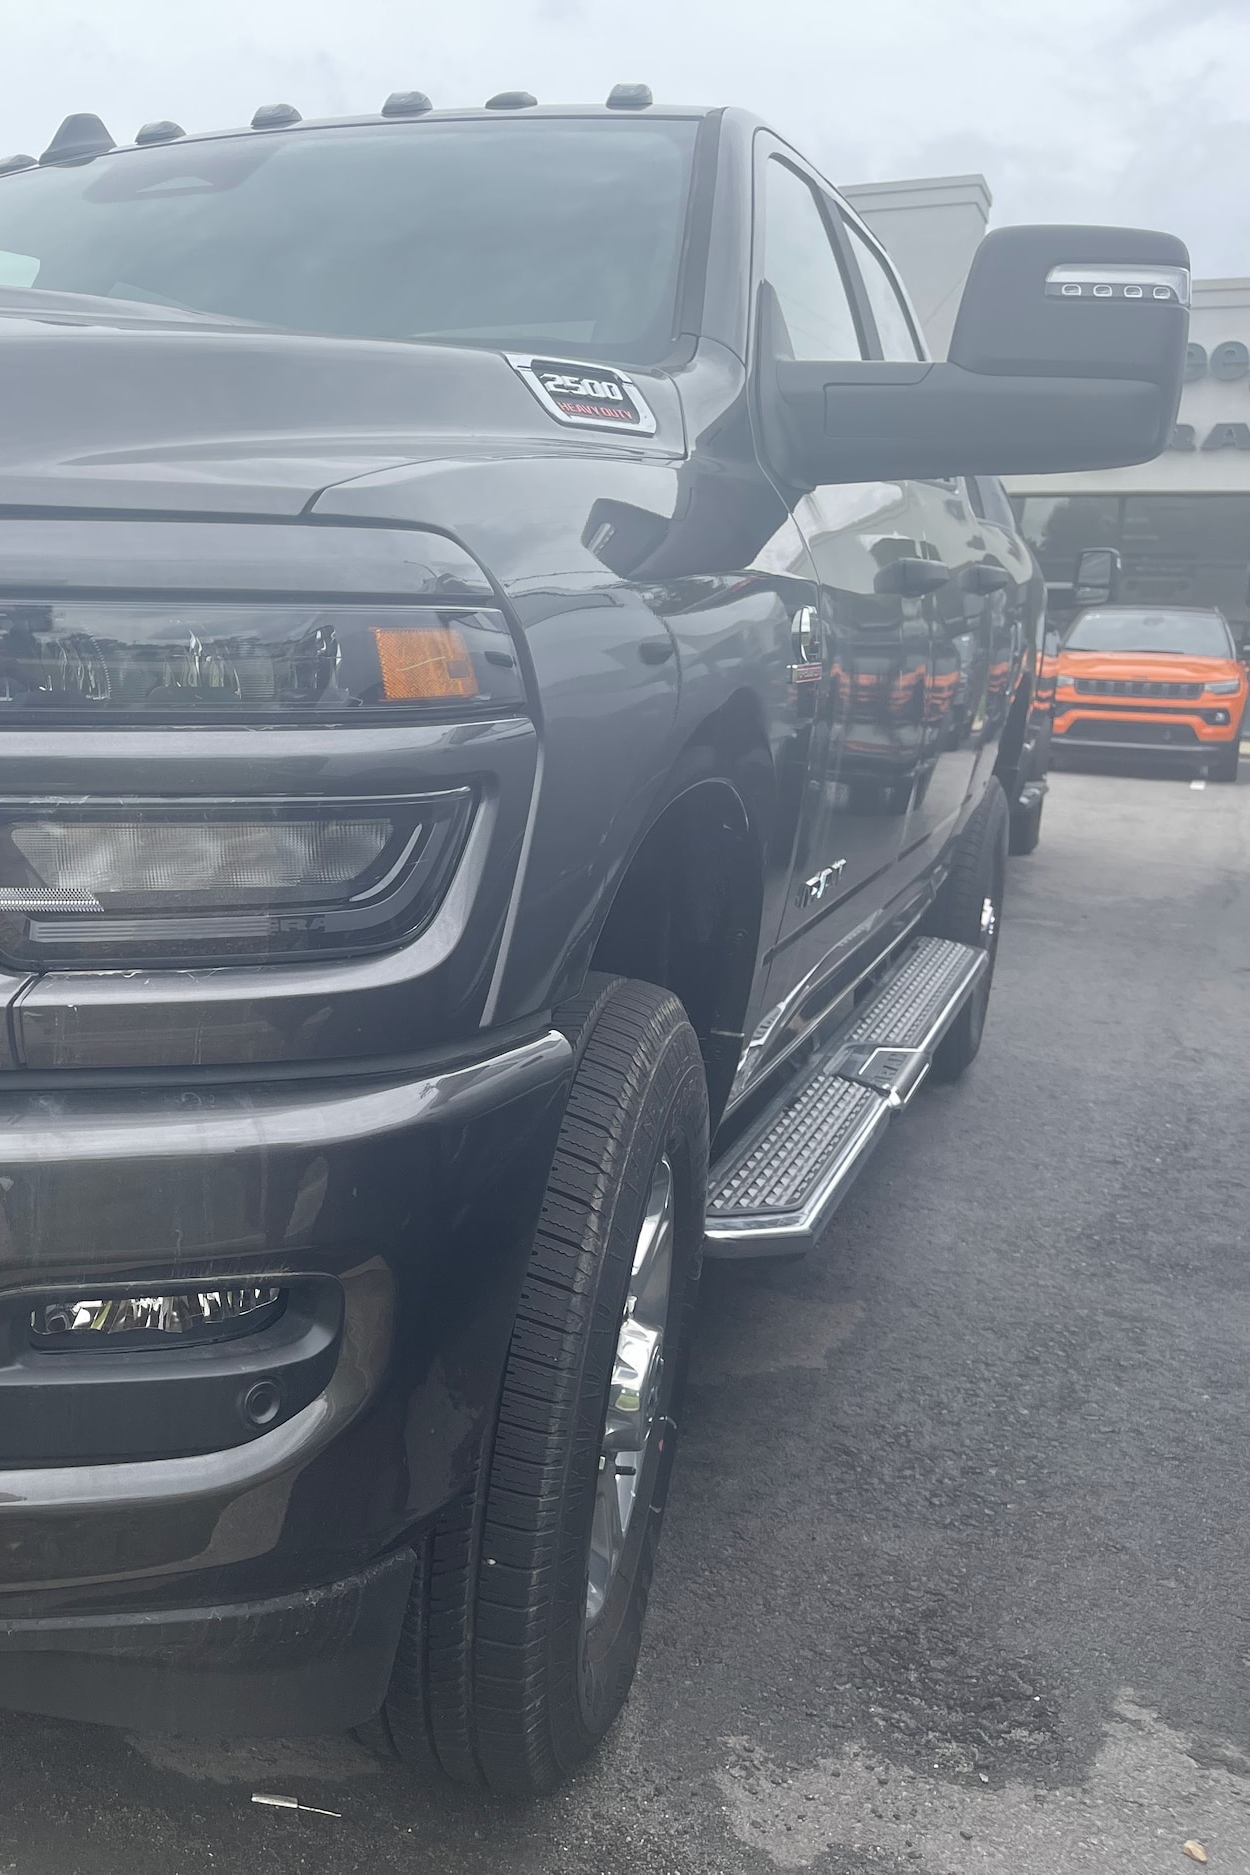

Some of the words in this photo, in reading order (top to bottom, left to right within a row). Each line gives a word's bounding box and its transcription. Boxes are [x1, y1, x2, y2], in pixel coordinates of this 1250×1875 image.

[540, 373, 623, 401] 2500
[557, 402, 600, 416] HEAVY
[602, 408, 633, 420] DUTY
